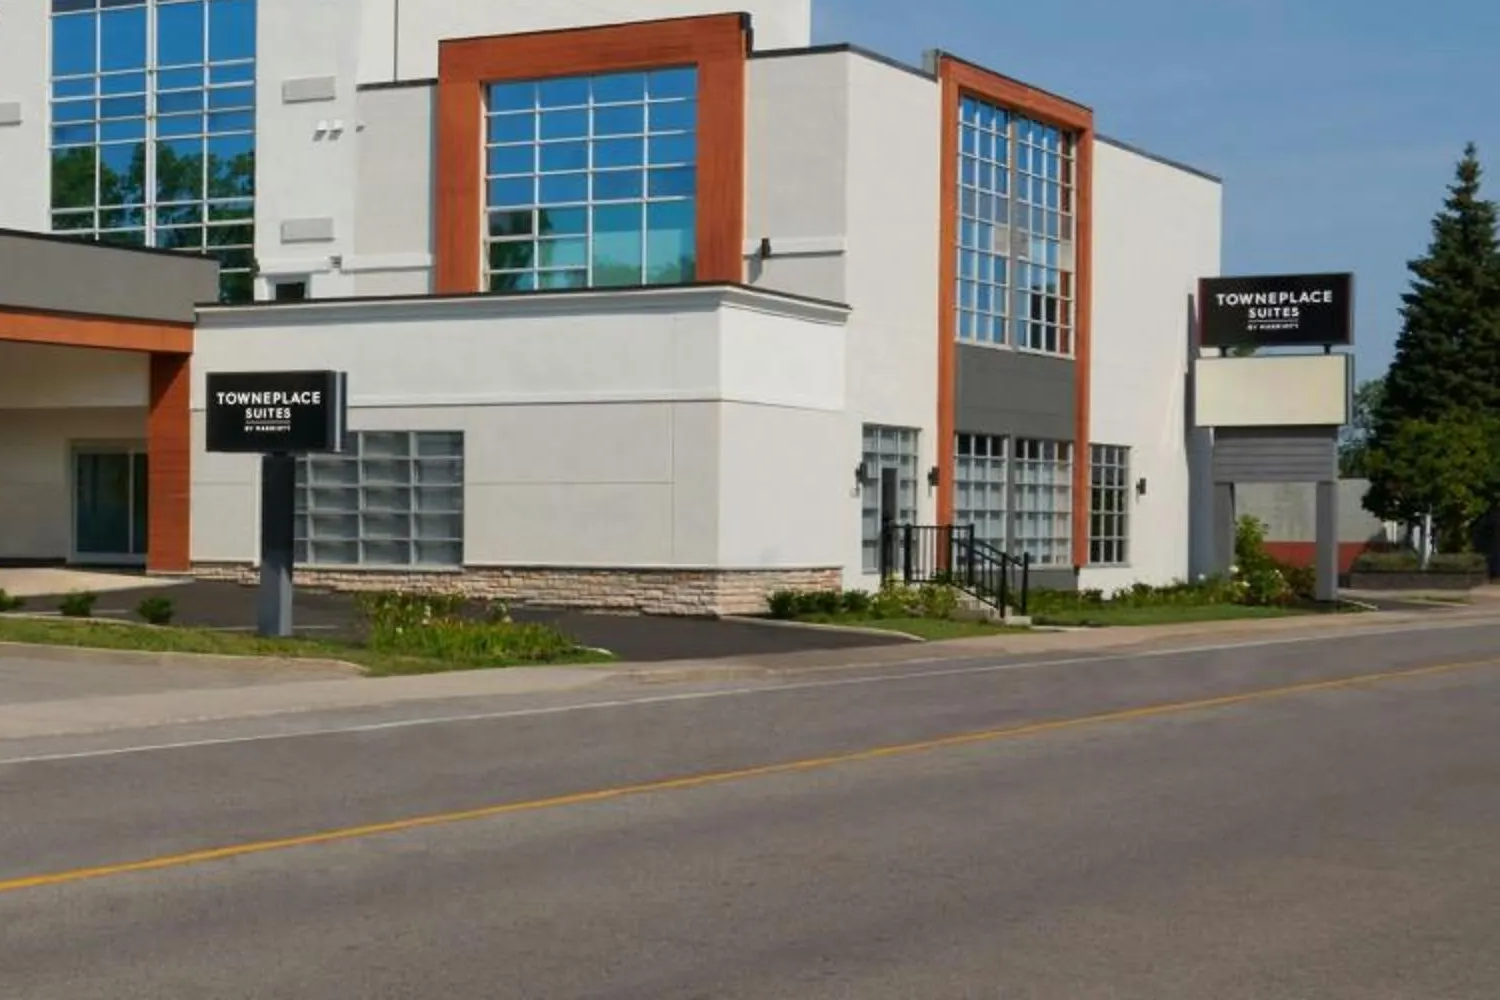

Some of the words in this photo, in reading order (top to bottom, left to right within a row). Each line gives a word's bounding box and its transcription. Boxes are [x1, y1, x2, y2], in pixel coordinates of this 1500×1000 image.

[1216, 290, 1333, 306] TOWNEPLACE
[1248, 307, 1300, 319] SUITES
[216, 391, 321, 405] TOWNEPLACE
[245, 407, 292, 419] SUITES
